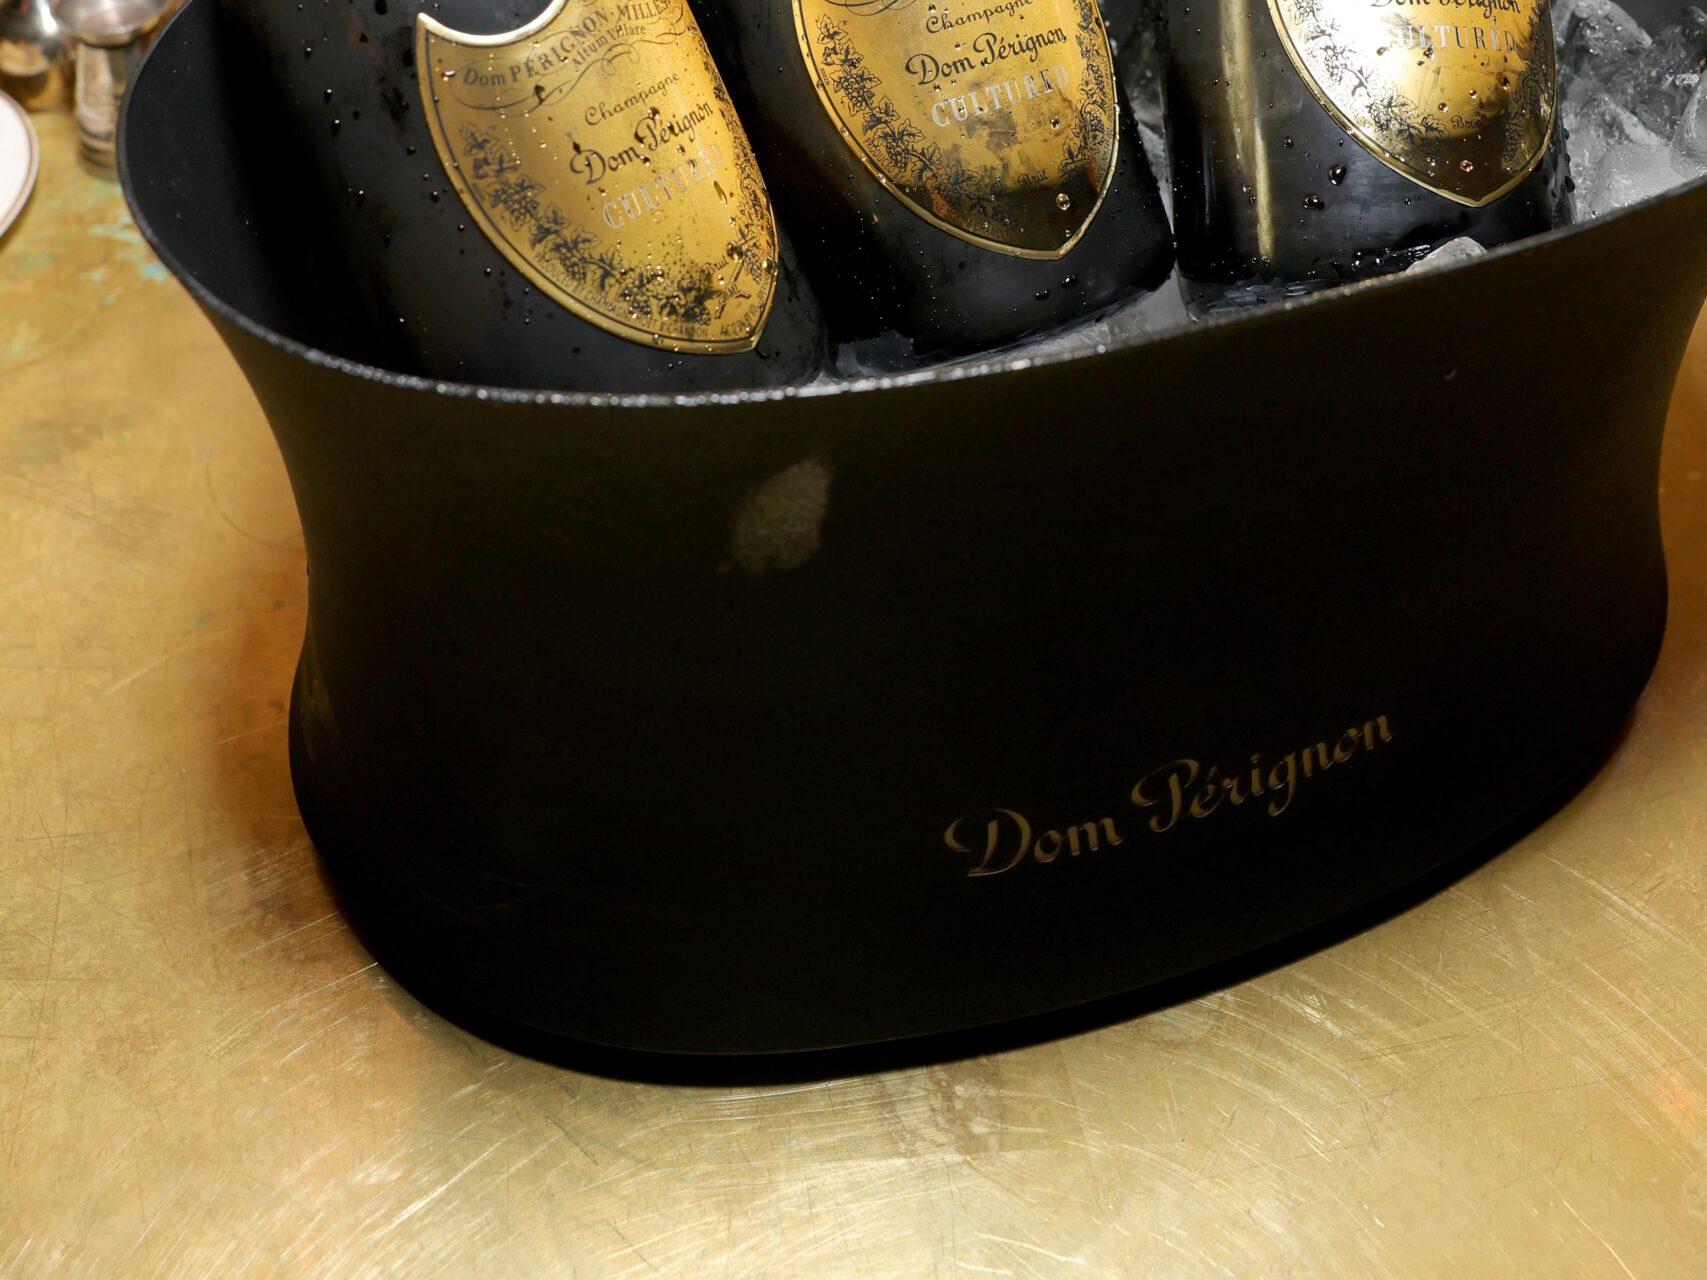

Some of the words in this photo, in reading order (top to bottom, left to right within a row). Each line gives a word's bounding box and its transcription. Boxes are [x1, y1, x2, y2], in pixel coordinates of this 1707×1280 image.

[570, 35, 608, 69] Altum
[905, 53, 976, 85] Dom
[973, 27, 1067, 66] Pérignon
[1397, 25, 1516, 52] ULTURED
[463, 67, 506, 86] Dom
[931, 64, 1069, 128] CULTURED
[585, 72, 679, 126] Champagne
[570, 146, 641, 185] Dom
[1017, 170, 1048, 187] Brut
[944, 807, 1123, 877] Dom
[1130, 714, 1394, 833] Pérignon
